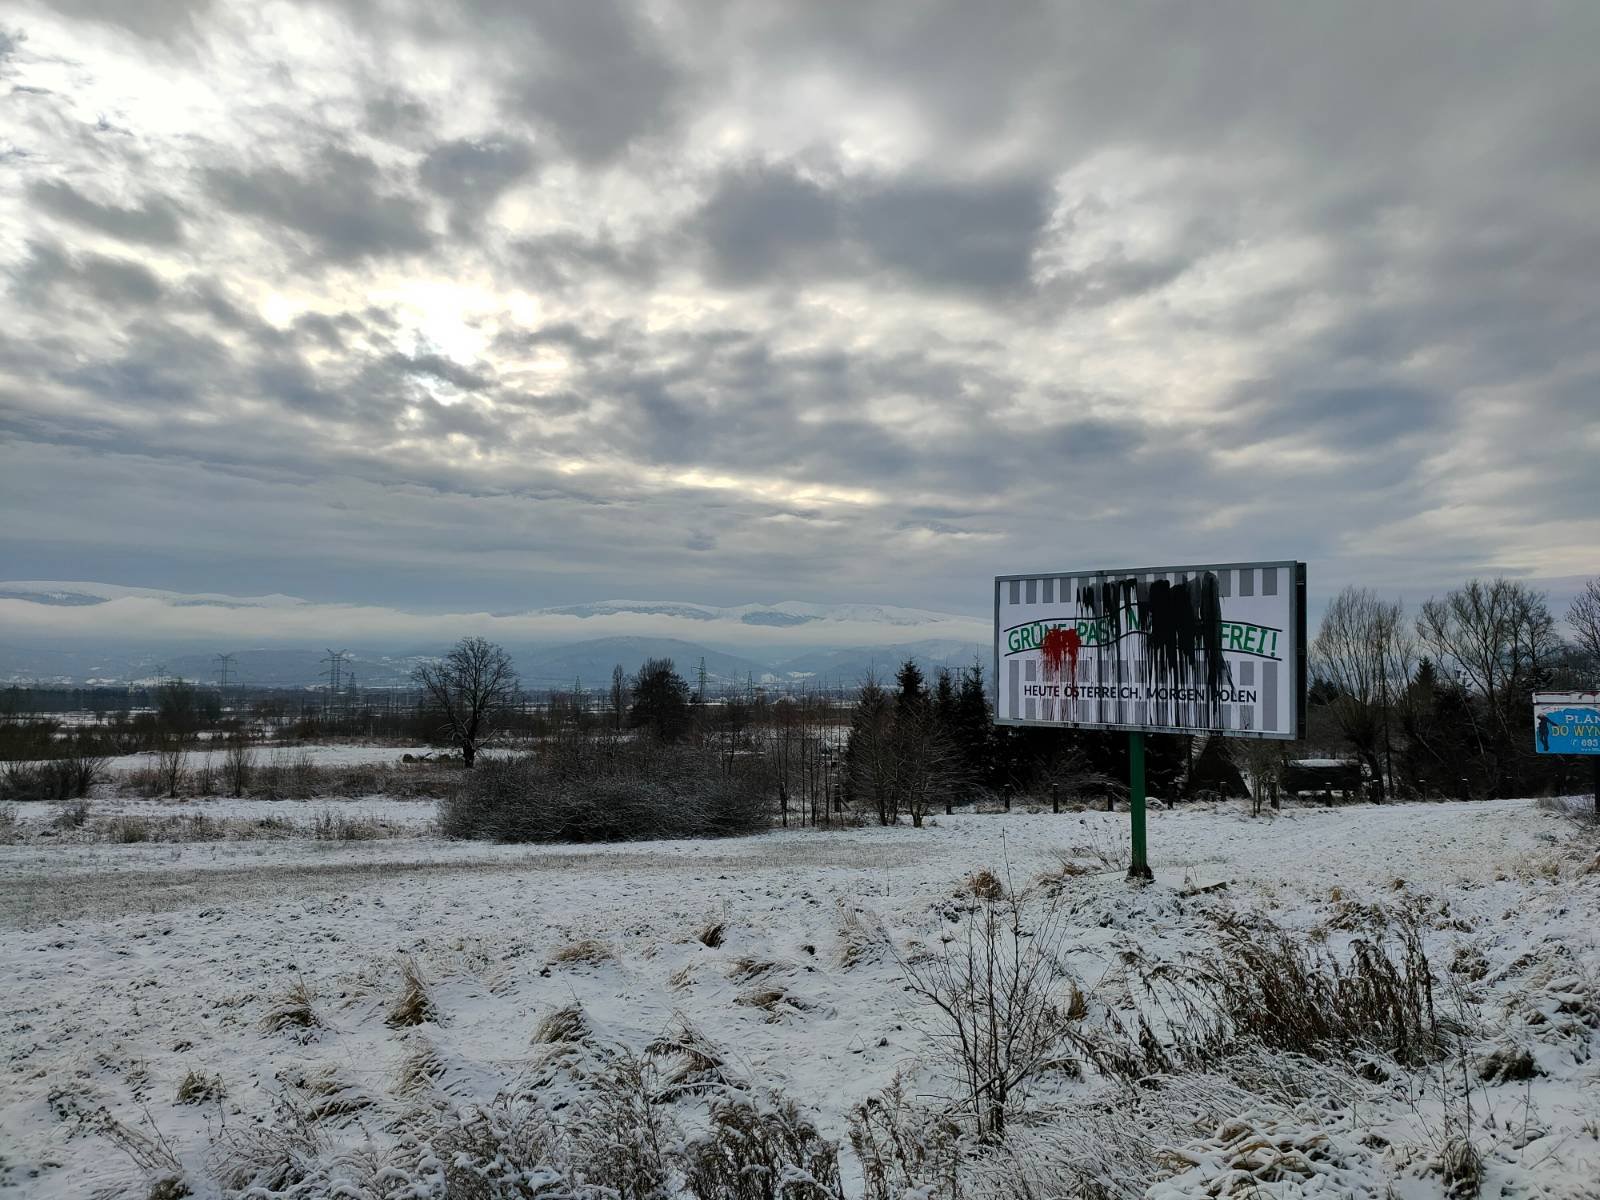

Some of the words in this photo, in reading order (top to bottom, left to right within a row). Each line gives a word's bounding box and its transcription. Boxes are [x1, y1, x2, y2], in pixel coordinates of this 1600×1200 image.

[1008, 622, 1067, 652] GRÜ
[1077, 617, 1120, 646] PAS
[1216, 623, 1278, 657] FREI!
[1024, 685, 1060, 697] HEUTE
[1064, 683, 1142, 700] ÖSTERREICH,
[1146, 687, 1205, 702] MORGEN
[1552, 725, 1569, 737] DO
